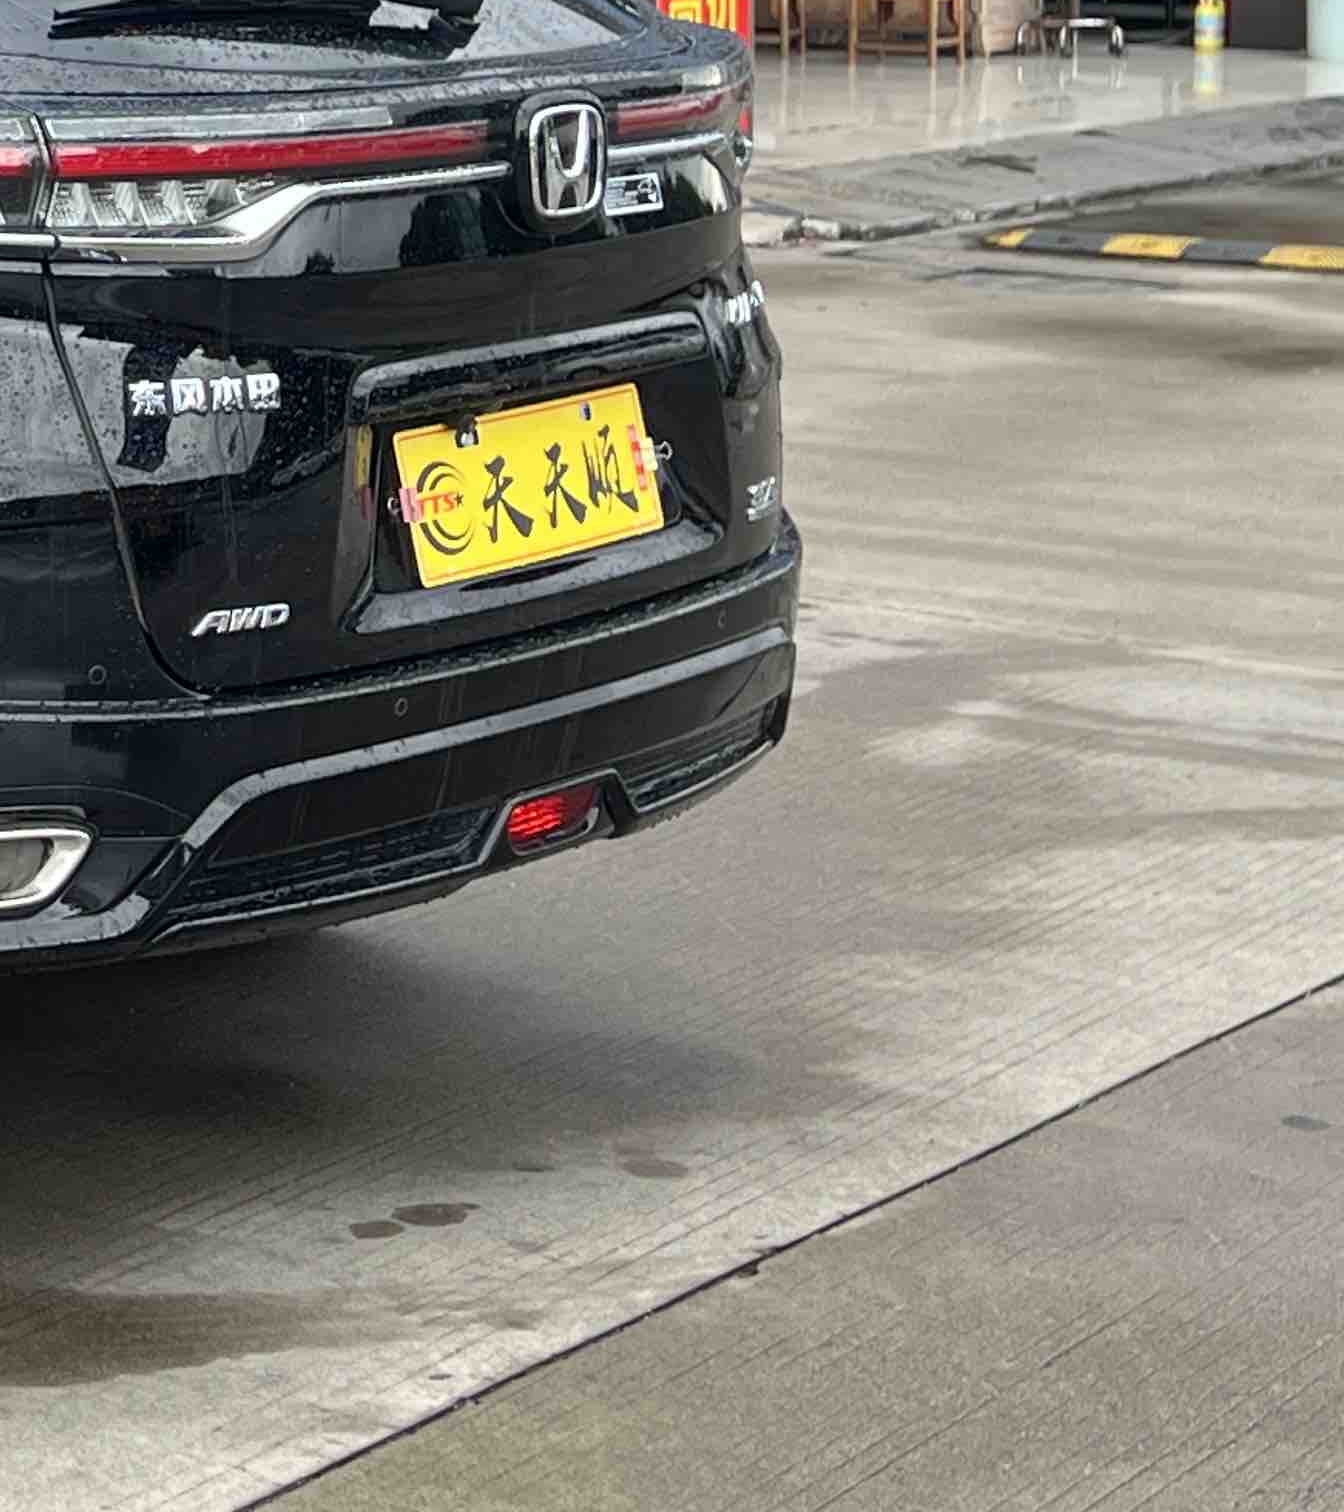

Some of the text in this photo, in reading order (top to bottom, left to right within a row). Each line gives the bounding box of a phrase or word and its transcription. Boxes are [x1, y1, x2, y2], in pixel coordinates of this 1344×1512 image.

[482, 425, 640, 544] 天天顺
[191, 602, 291, 637] AWD
